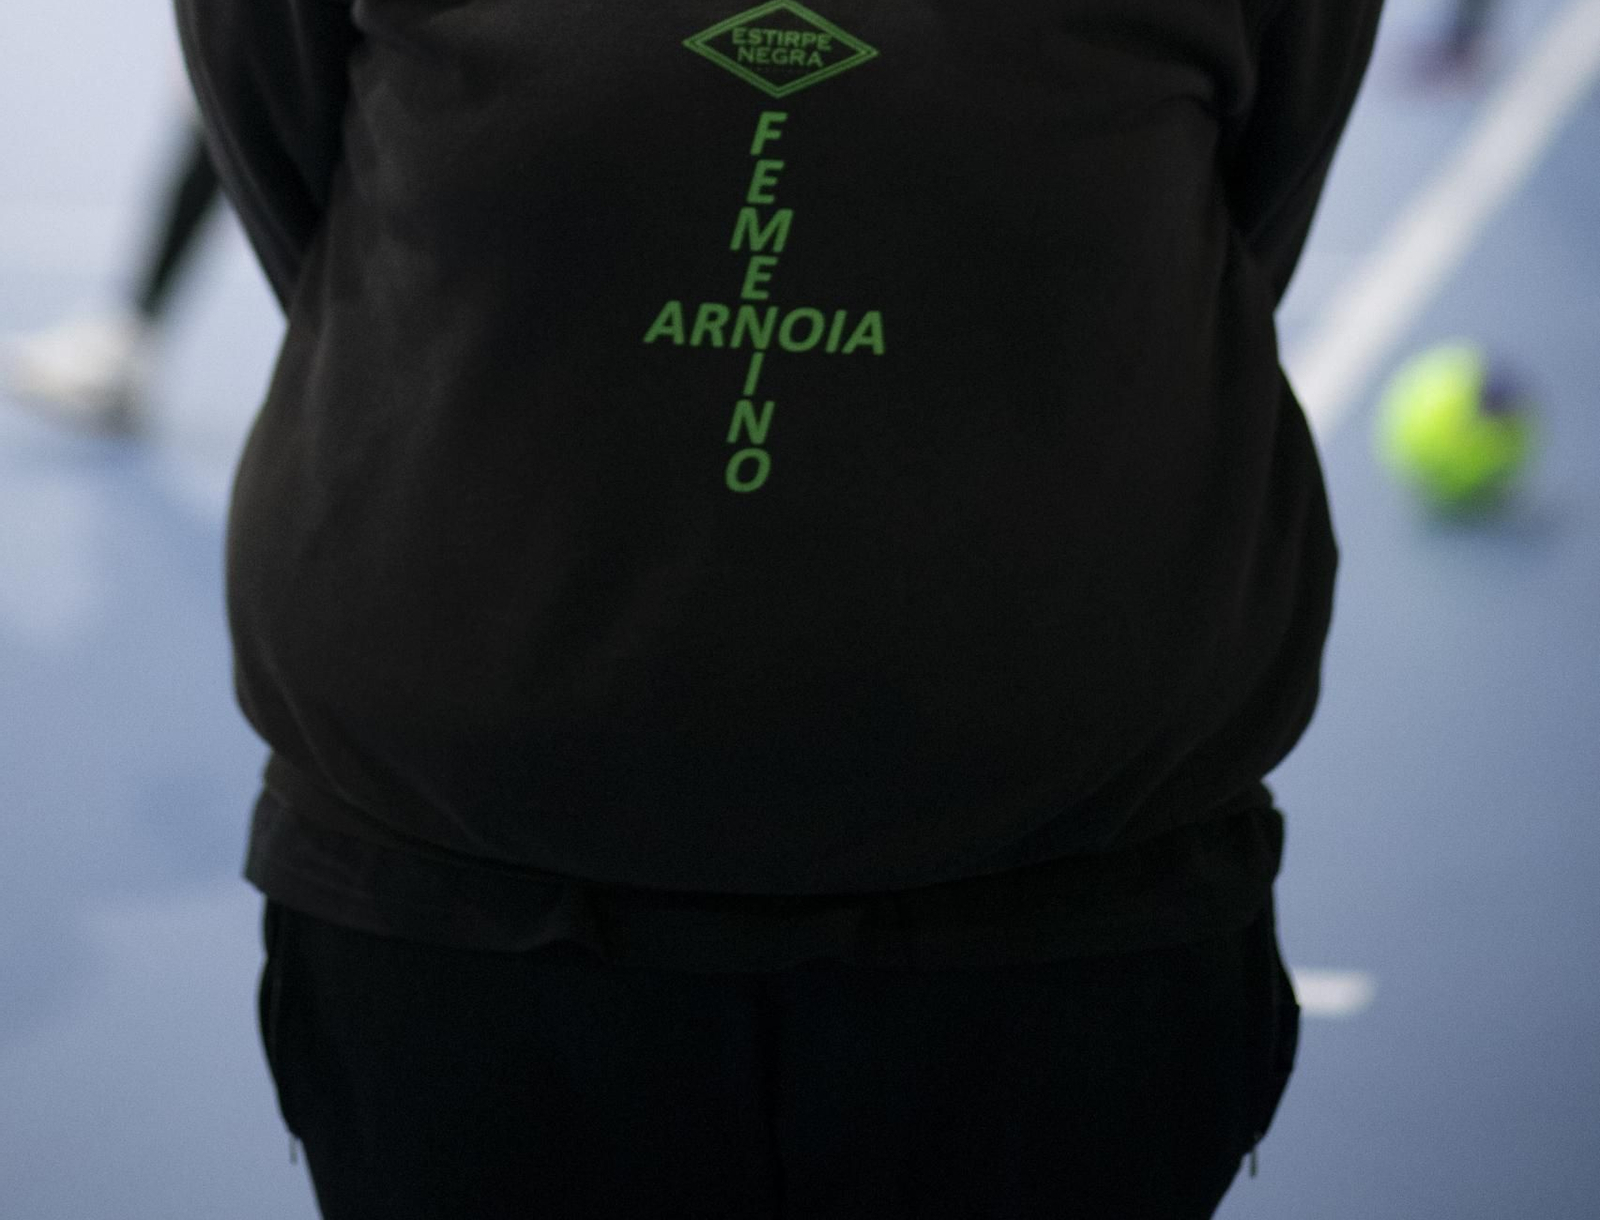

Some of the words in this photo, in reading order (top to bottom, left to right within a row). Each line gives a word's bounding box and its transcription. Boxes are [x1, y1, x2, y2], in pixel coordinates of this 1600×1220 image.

[731, 27, 832, 52] ESTIRPE
[737, 46, 823, 68] NEGRA
[725, 111, 794, 493] FEMENINO
[643, 300, 885, 355] ARNOIA
